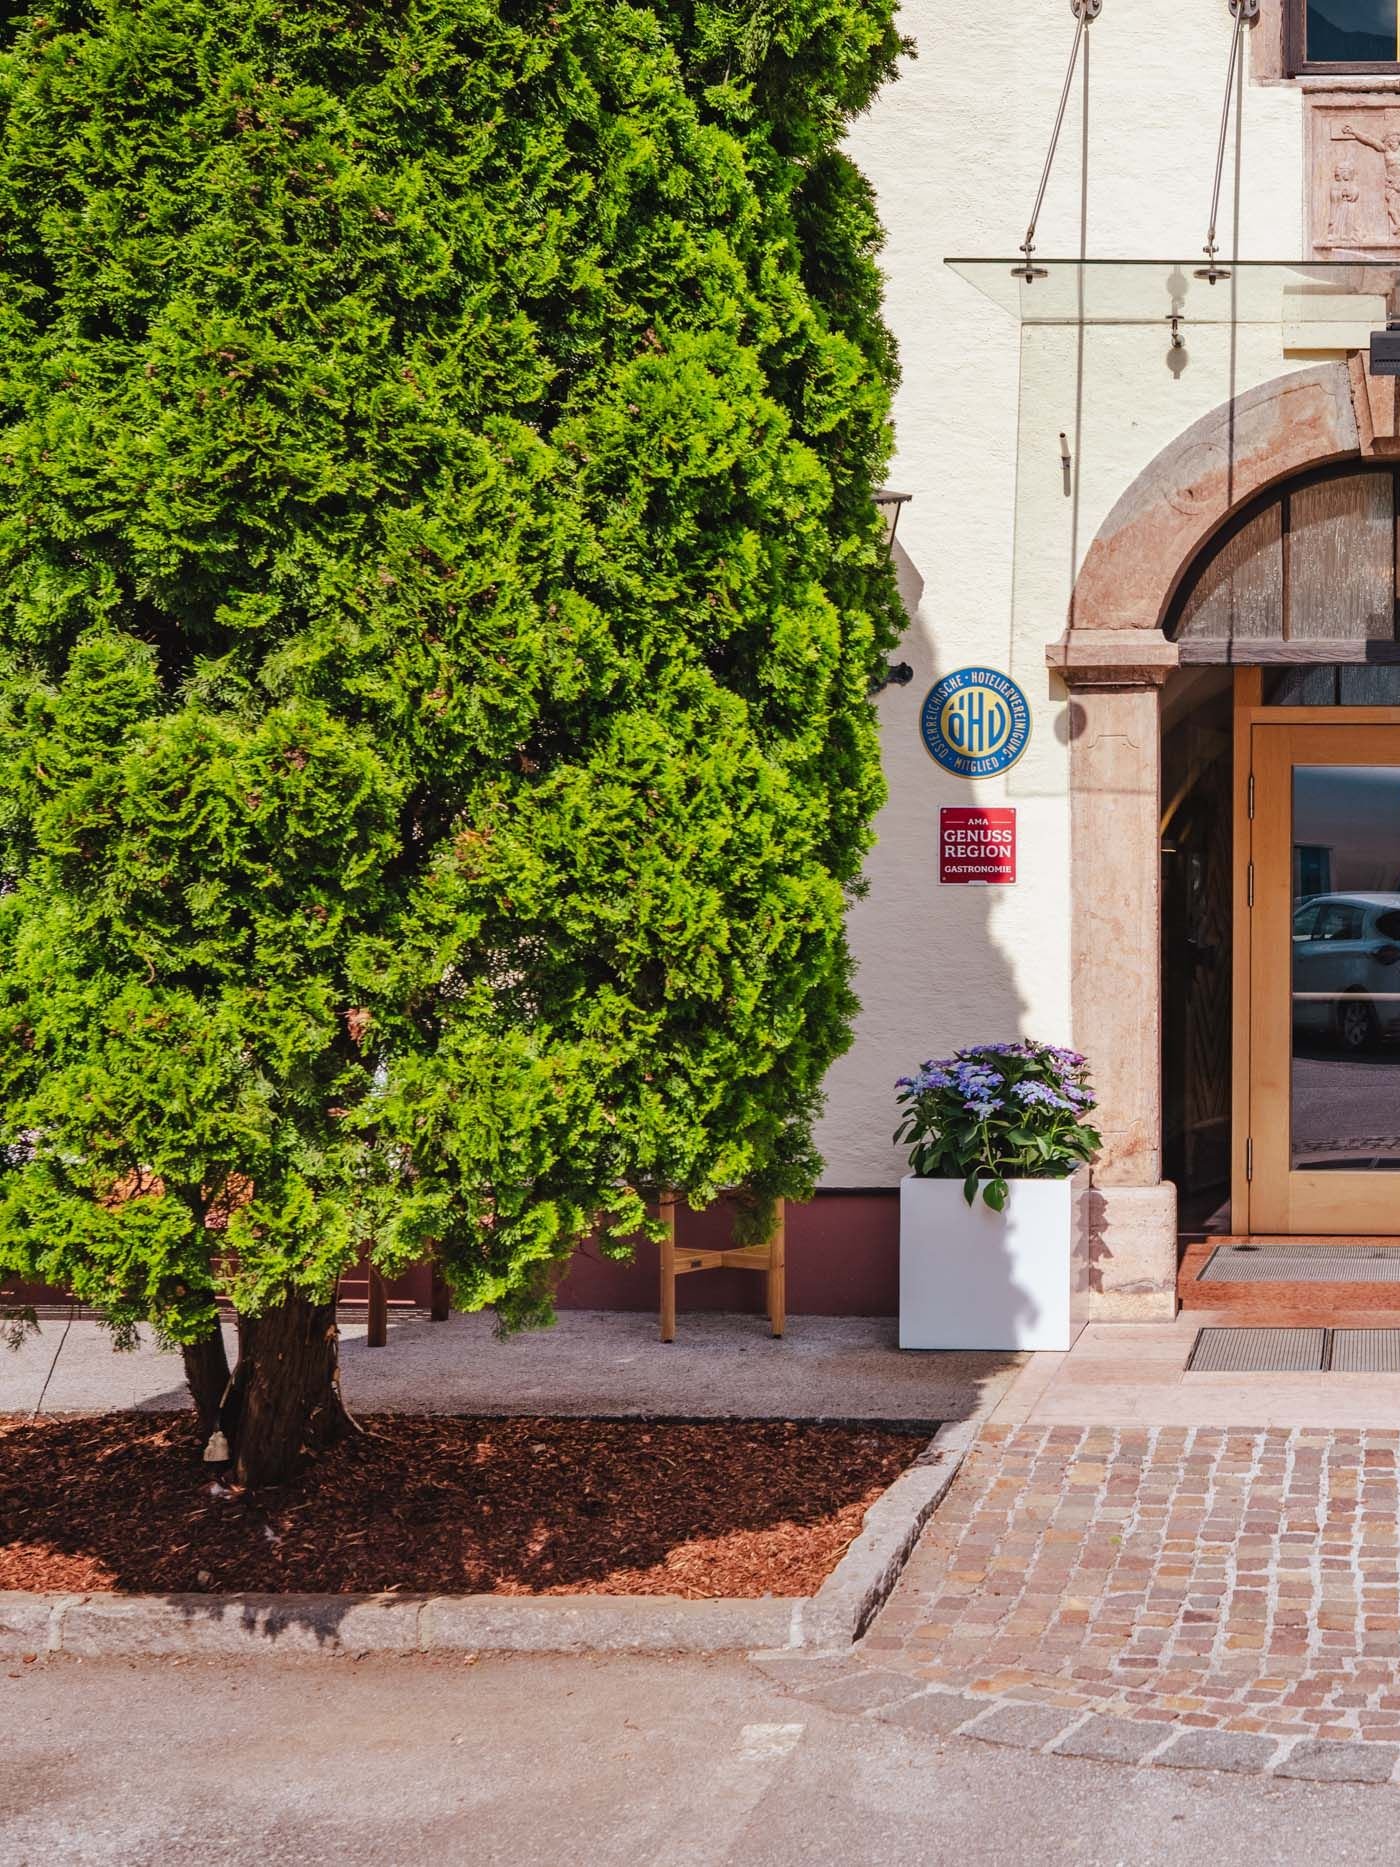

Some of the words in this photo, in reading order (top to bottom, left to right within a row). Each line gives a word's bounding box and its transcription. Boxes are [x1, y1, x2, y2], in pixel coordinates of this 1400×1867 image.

[971, 671, 1026, 758] HOTELIERVEREINIGUNG
[954, 756, 1000, 773] MITGLIED
[944, 829, 1012, 842] GENUSS
[944, 845, 1012, 857] REGION
[944, 865, 1011, 873] GASTRONOMIE
